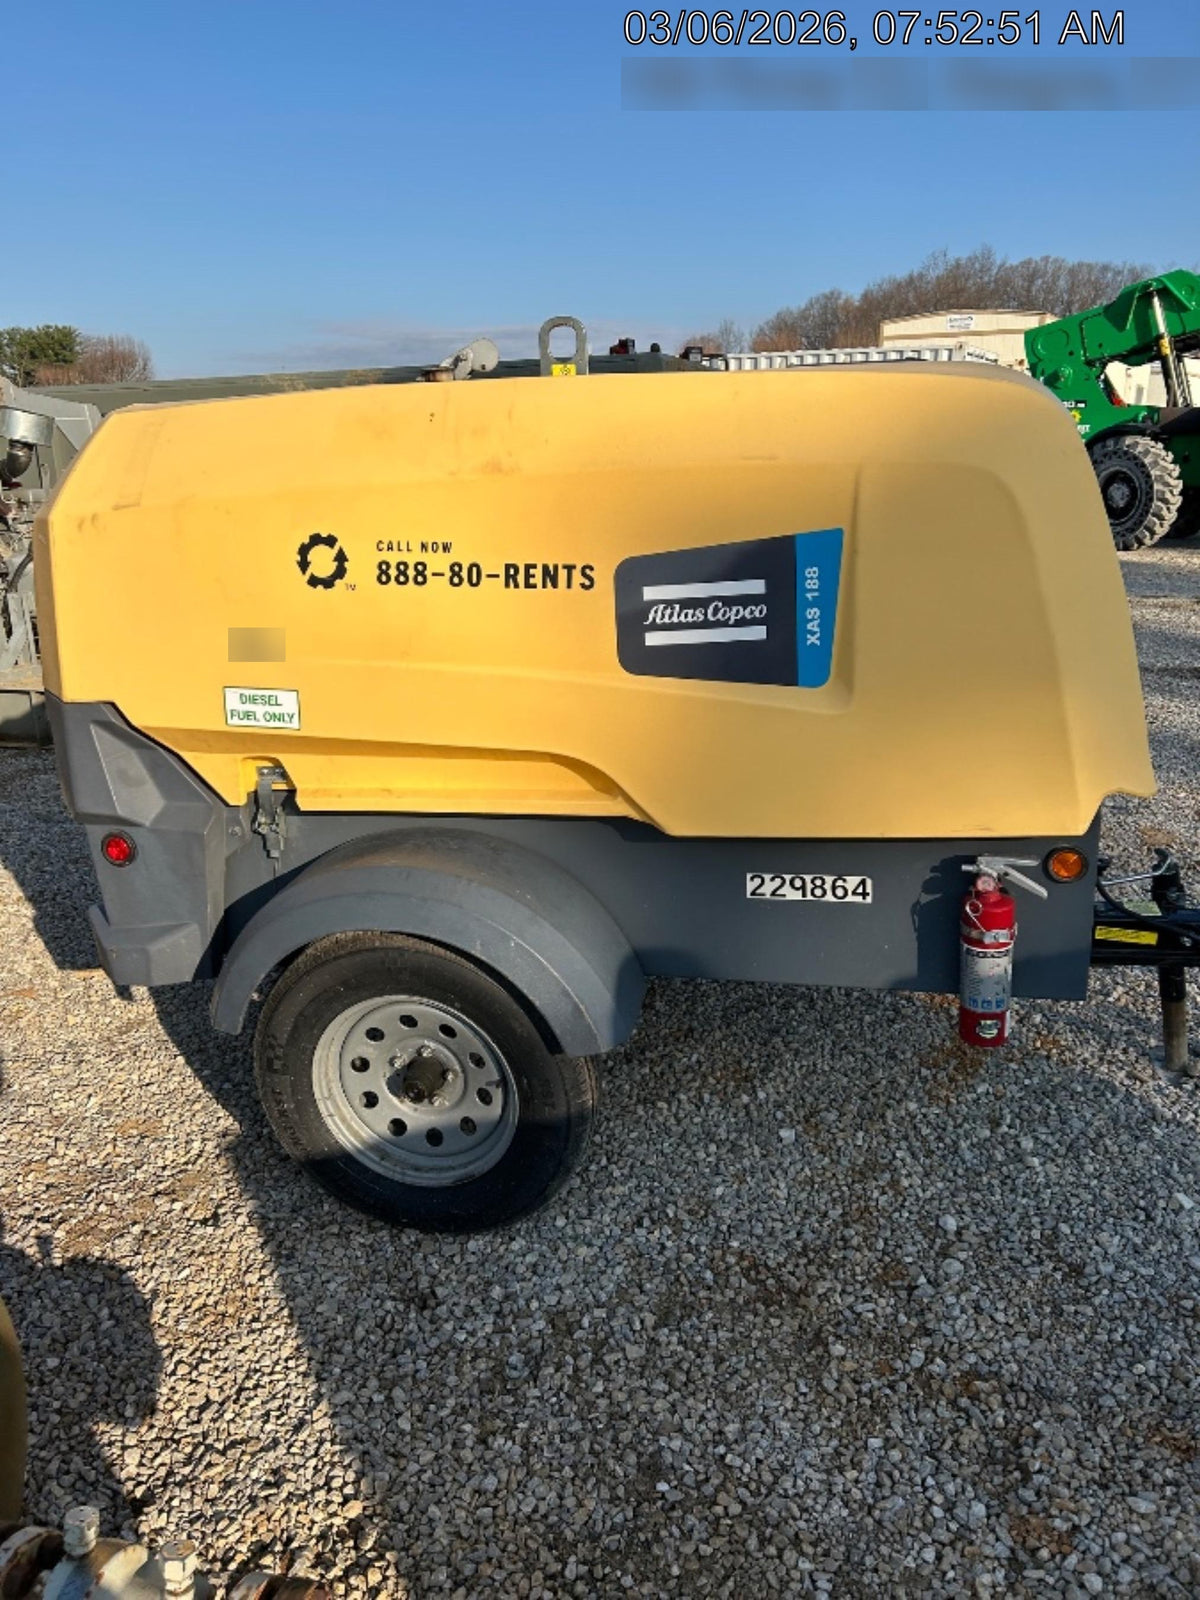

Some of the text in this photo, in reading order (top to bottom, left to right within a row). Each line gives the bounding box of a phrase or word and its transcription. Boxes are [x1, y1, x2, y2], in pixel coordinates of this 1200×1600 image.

[376, 540, 453, 554] CALL NOW
[376, 560, 595, 590] 888-80-RENTS
[643, 600, 768, 625] Atlas Copco
[805, 566, 821, 647] XAS 188
[239, 692, 283, 707] DIESEL
[229, 708, 296, 724] FUEL ONLY
[749, 874, 870, 901] 229864
